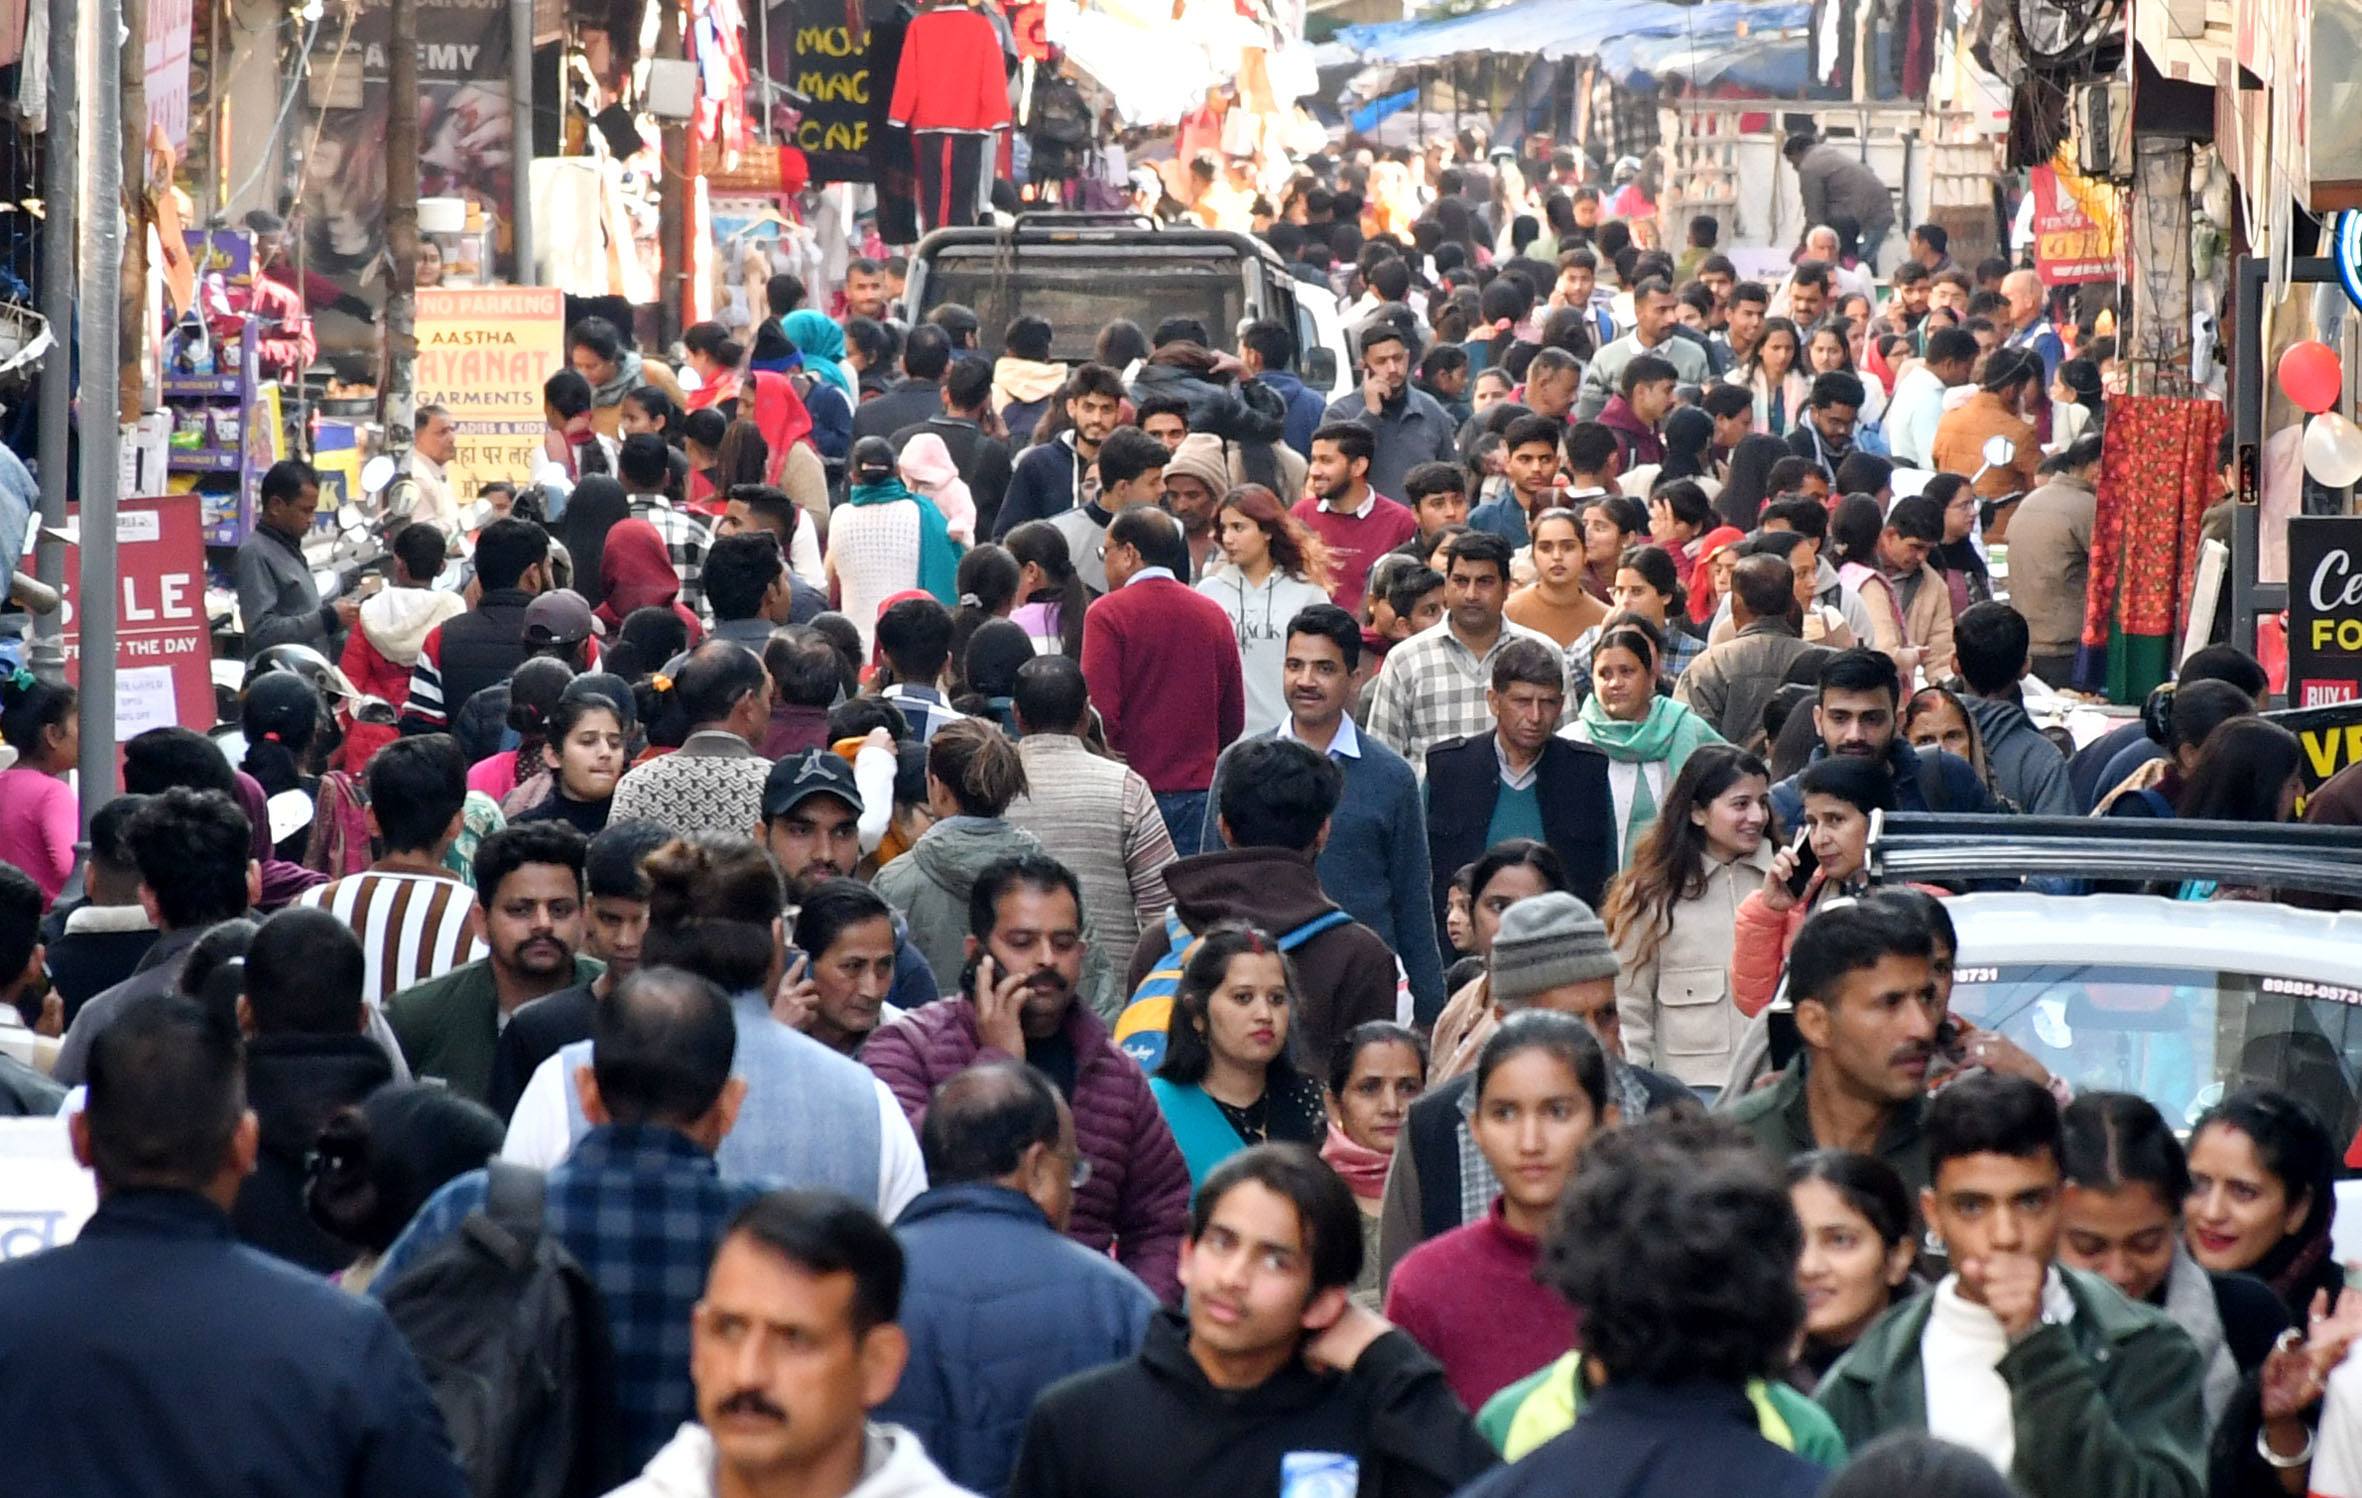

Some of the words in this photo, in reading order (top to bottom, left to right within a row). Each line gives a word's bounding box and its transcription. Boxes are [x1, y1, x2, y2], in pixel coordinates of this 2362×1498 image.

[422, 295, 453, 314] NO
[460, 294, 555, 314] PARKING
[430, 330, 517, 345] AASTHA
[415, 390, 534, 406] GARMENTS
[454, 421, 496, 434] ADIES
[126, 639, 161, 656] THE
[164, 636, 197, 654] DAY
